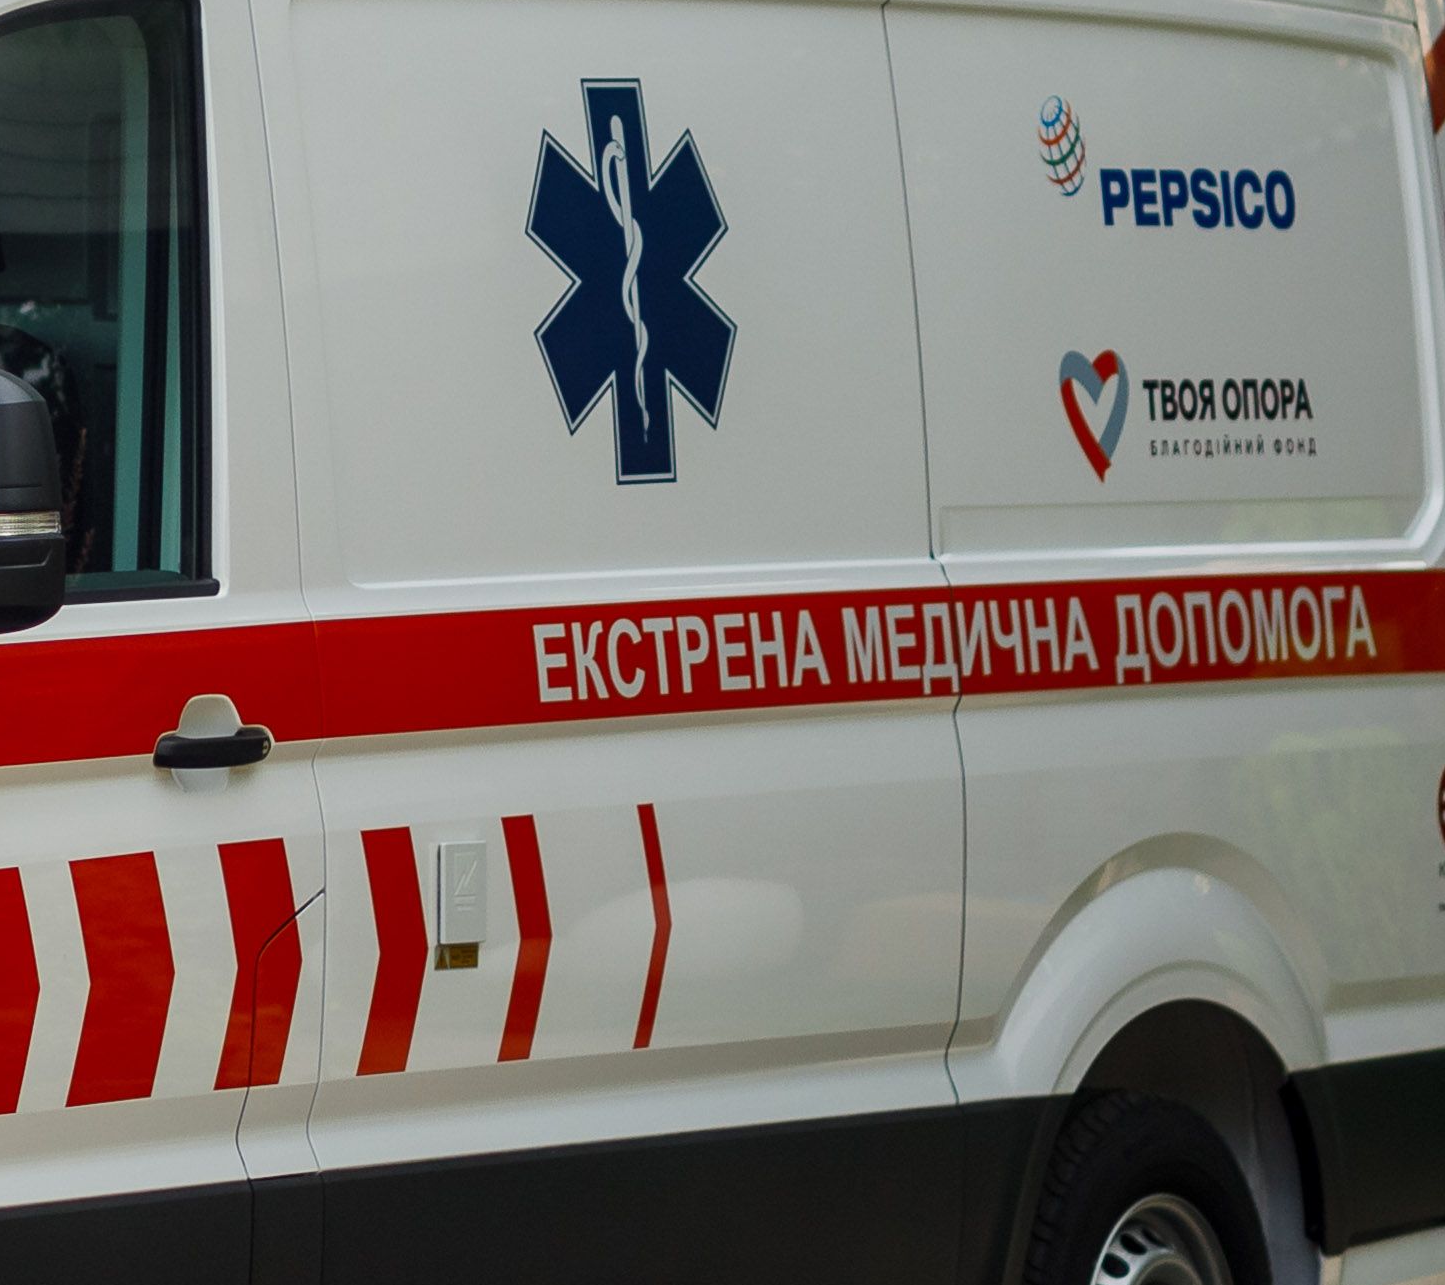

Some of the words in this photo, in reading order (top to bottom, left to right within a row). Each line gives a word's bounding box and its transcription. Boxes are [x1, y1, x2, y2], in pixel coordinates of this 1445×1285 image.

[1100, 168, 1296, 230] PEPSICO
[1142, 378, 1215, 421] ТВОЯ
[1222, 378, 1314, 420] ОПОРА
[1149, 433, 1266, 459] БЛАГОДІЙНИЙ
[1273, 436, 1318, 457] ФОНД
[531, 607, 831, 703] ЕКСТРЕНА
[841, 596, 1100, 695] МЕДИЧНА
[1114, 584, 1378, 684] ДОПОМОГА
